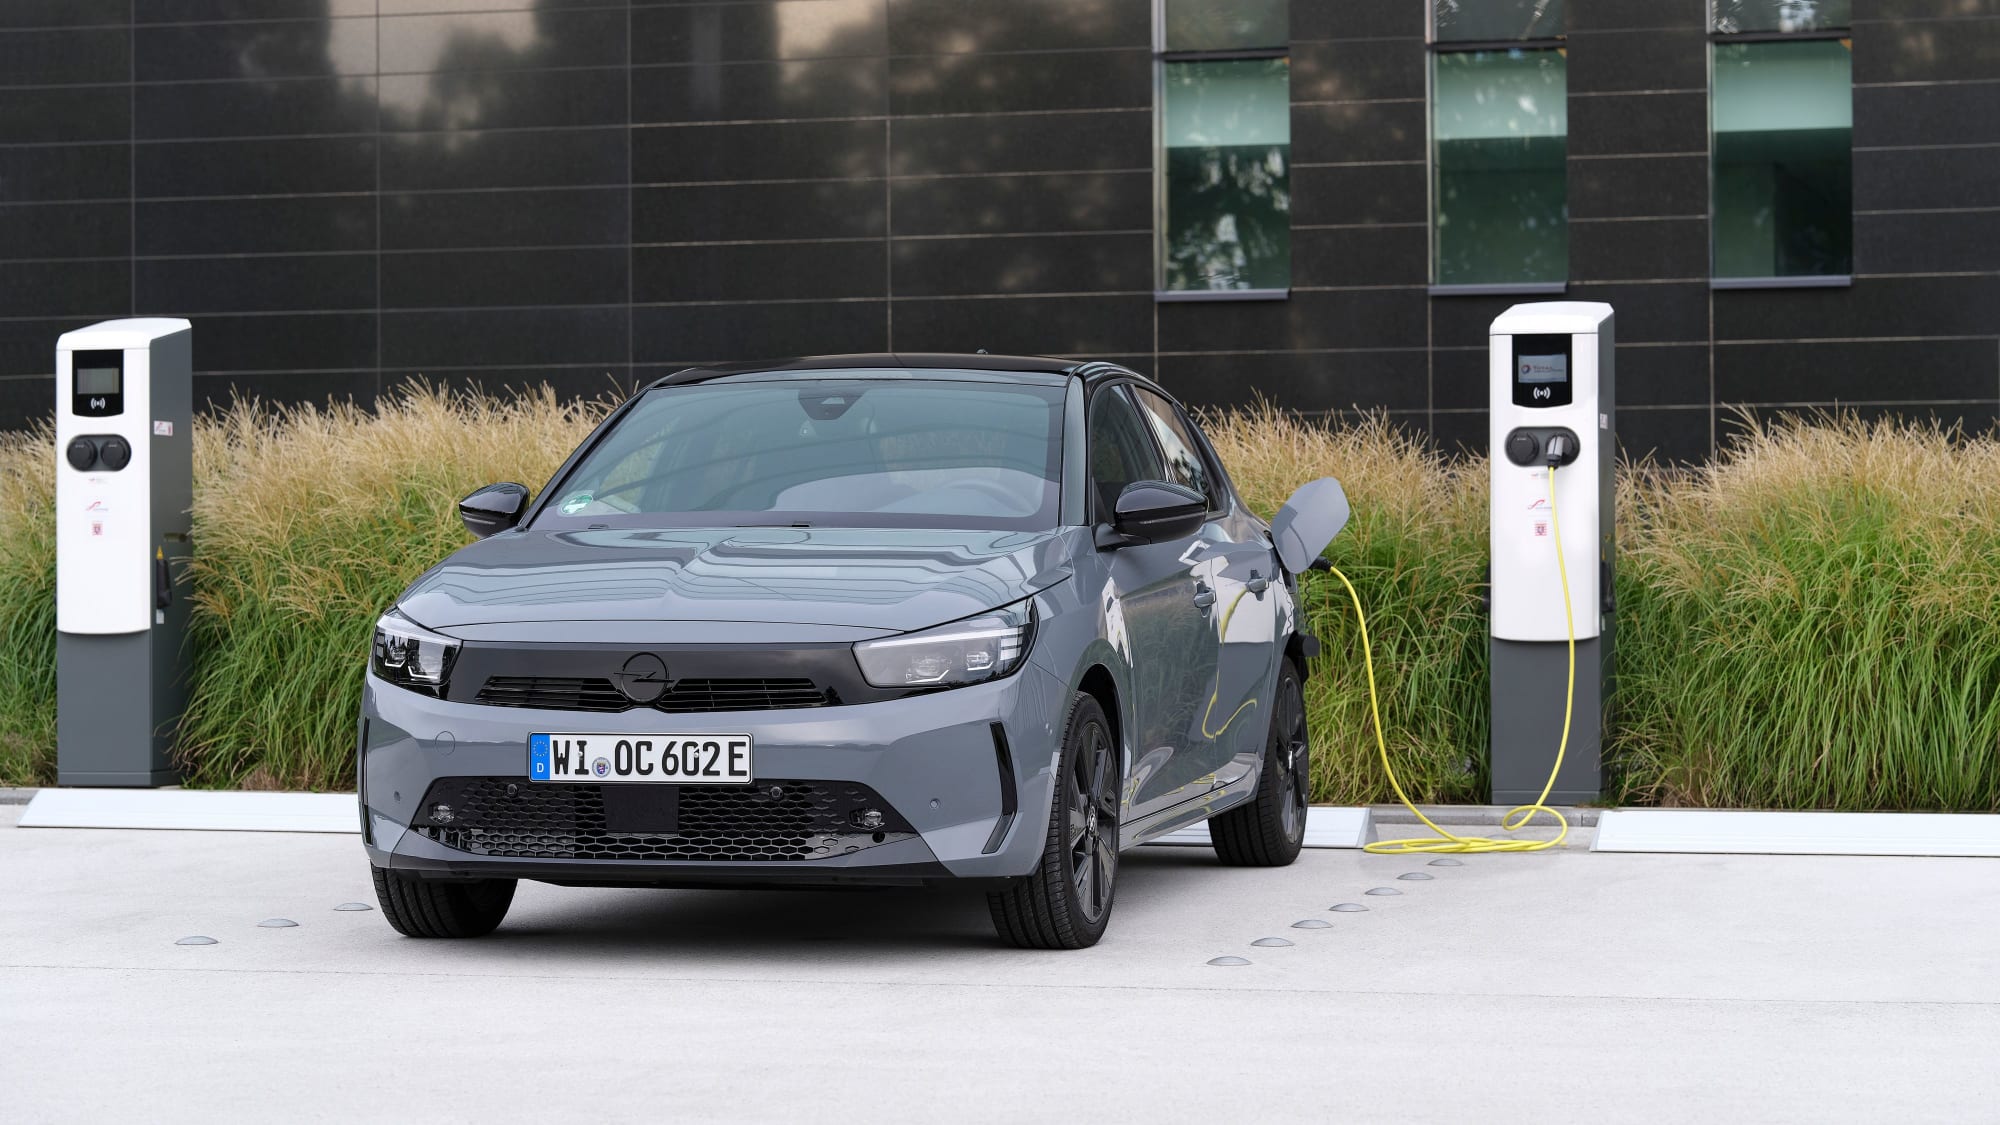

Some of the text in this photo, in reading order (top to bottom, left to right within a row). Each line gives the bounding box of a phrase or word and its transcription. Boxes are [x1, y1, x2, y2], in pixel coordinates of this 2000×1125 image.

[536, 762, 545, 773] D
[552, 739, 590, 775] WI
[614, 739, 654, 776] OC
